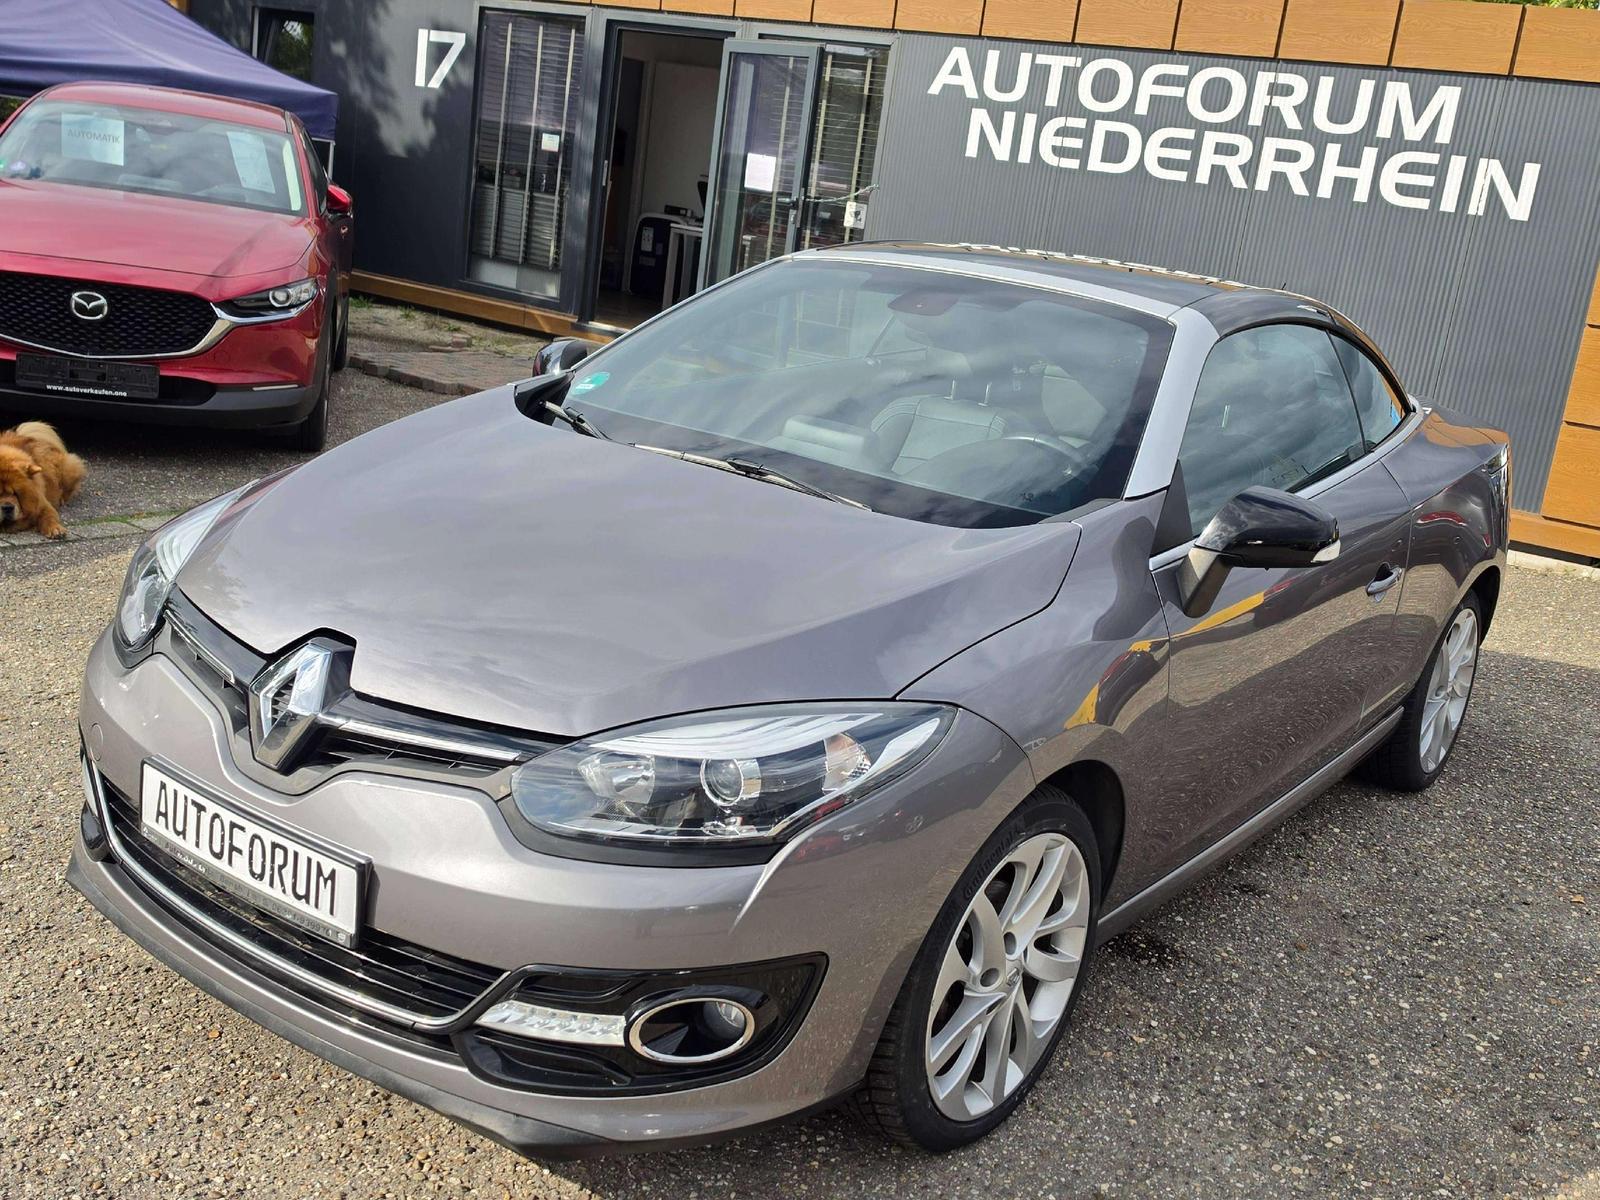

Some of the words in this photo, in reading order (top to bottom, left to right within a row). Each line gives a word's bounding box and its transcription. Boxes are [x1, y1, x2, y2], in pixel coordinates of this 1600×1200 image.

[414, 28, 466, 89] 17
[927, 47, 1462, 144] AUTOFORUM
[67, 128, 120, 144] AUTOMATIK
[964, 108, 1541, 221] NIEDERRHEIN
[46, 384, 127, 397] www.autoverkaufen.one
[155, 780, 336, 916] AUTOFORUM
